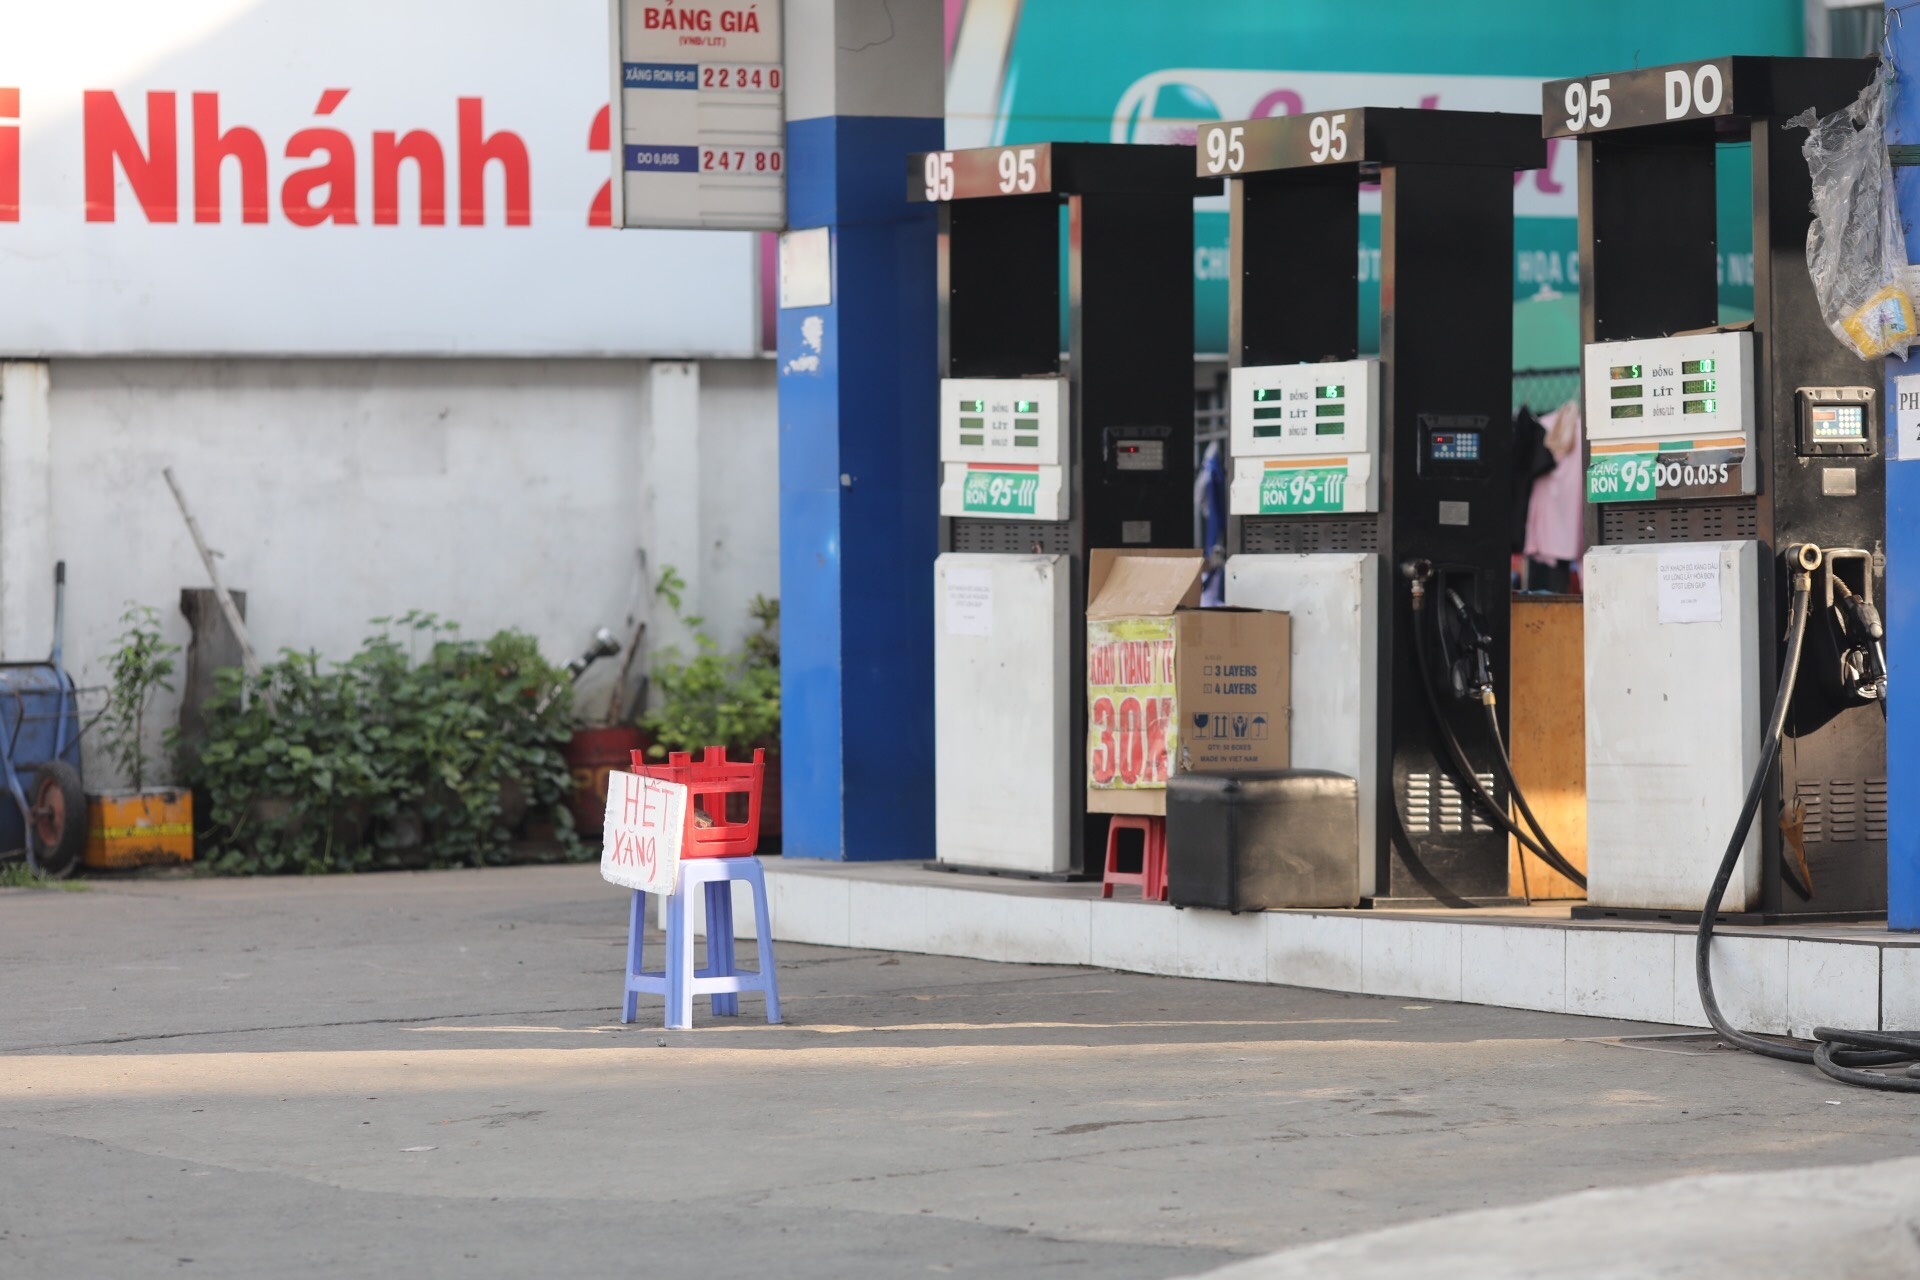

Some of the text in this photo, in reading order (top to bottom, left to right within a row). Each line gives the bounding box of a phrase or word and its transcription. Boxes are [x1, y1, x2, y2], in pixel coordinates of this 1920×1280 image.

[644, 0, 760, 33] BẢNG GIÁ
[626, 67, 652, 81] XĂNG
[653, 70, 674, 82] RON
[1565, 64, 1723, 132] 95 DO
[1206, 127, 1245, 173] 95
[1309, 115, 1348, 163] 95
[83, 88, 532, 228] Nhánh
[637, 152, 653, 164] DO
[924, 149, 1037, 202] 95 95
[1653, 386, 1674, 397] LÍT
[1591, 478, 1619, 493] RON
[1655, 462, 1682, 487] DO
[965, 490, 988, 505] RON
[1263, 490, 1288, 506] RON
[1215, 665, 1257, 676] 3 LAYERS
[1215, 683, 1257, 694] 4 LAYERS
[1093, 697, 1172, 785] 30K
[1200, 755, 1218, 763] MADE
[1221, 755, 1227, 763] IN
[1244, 755, 1259, 763] NAM
[624, 775, 675, 836] HẾT
